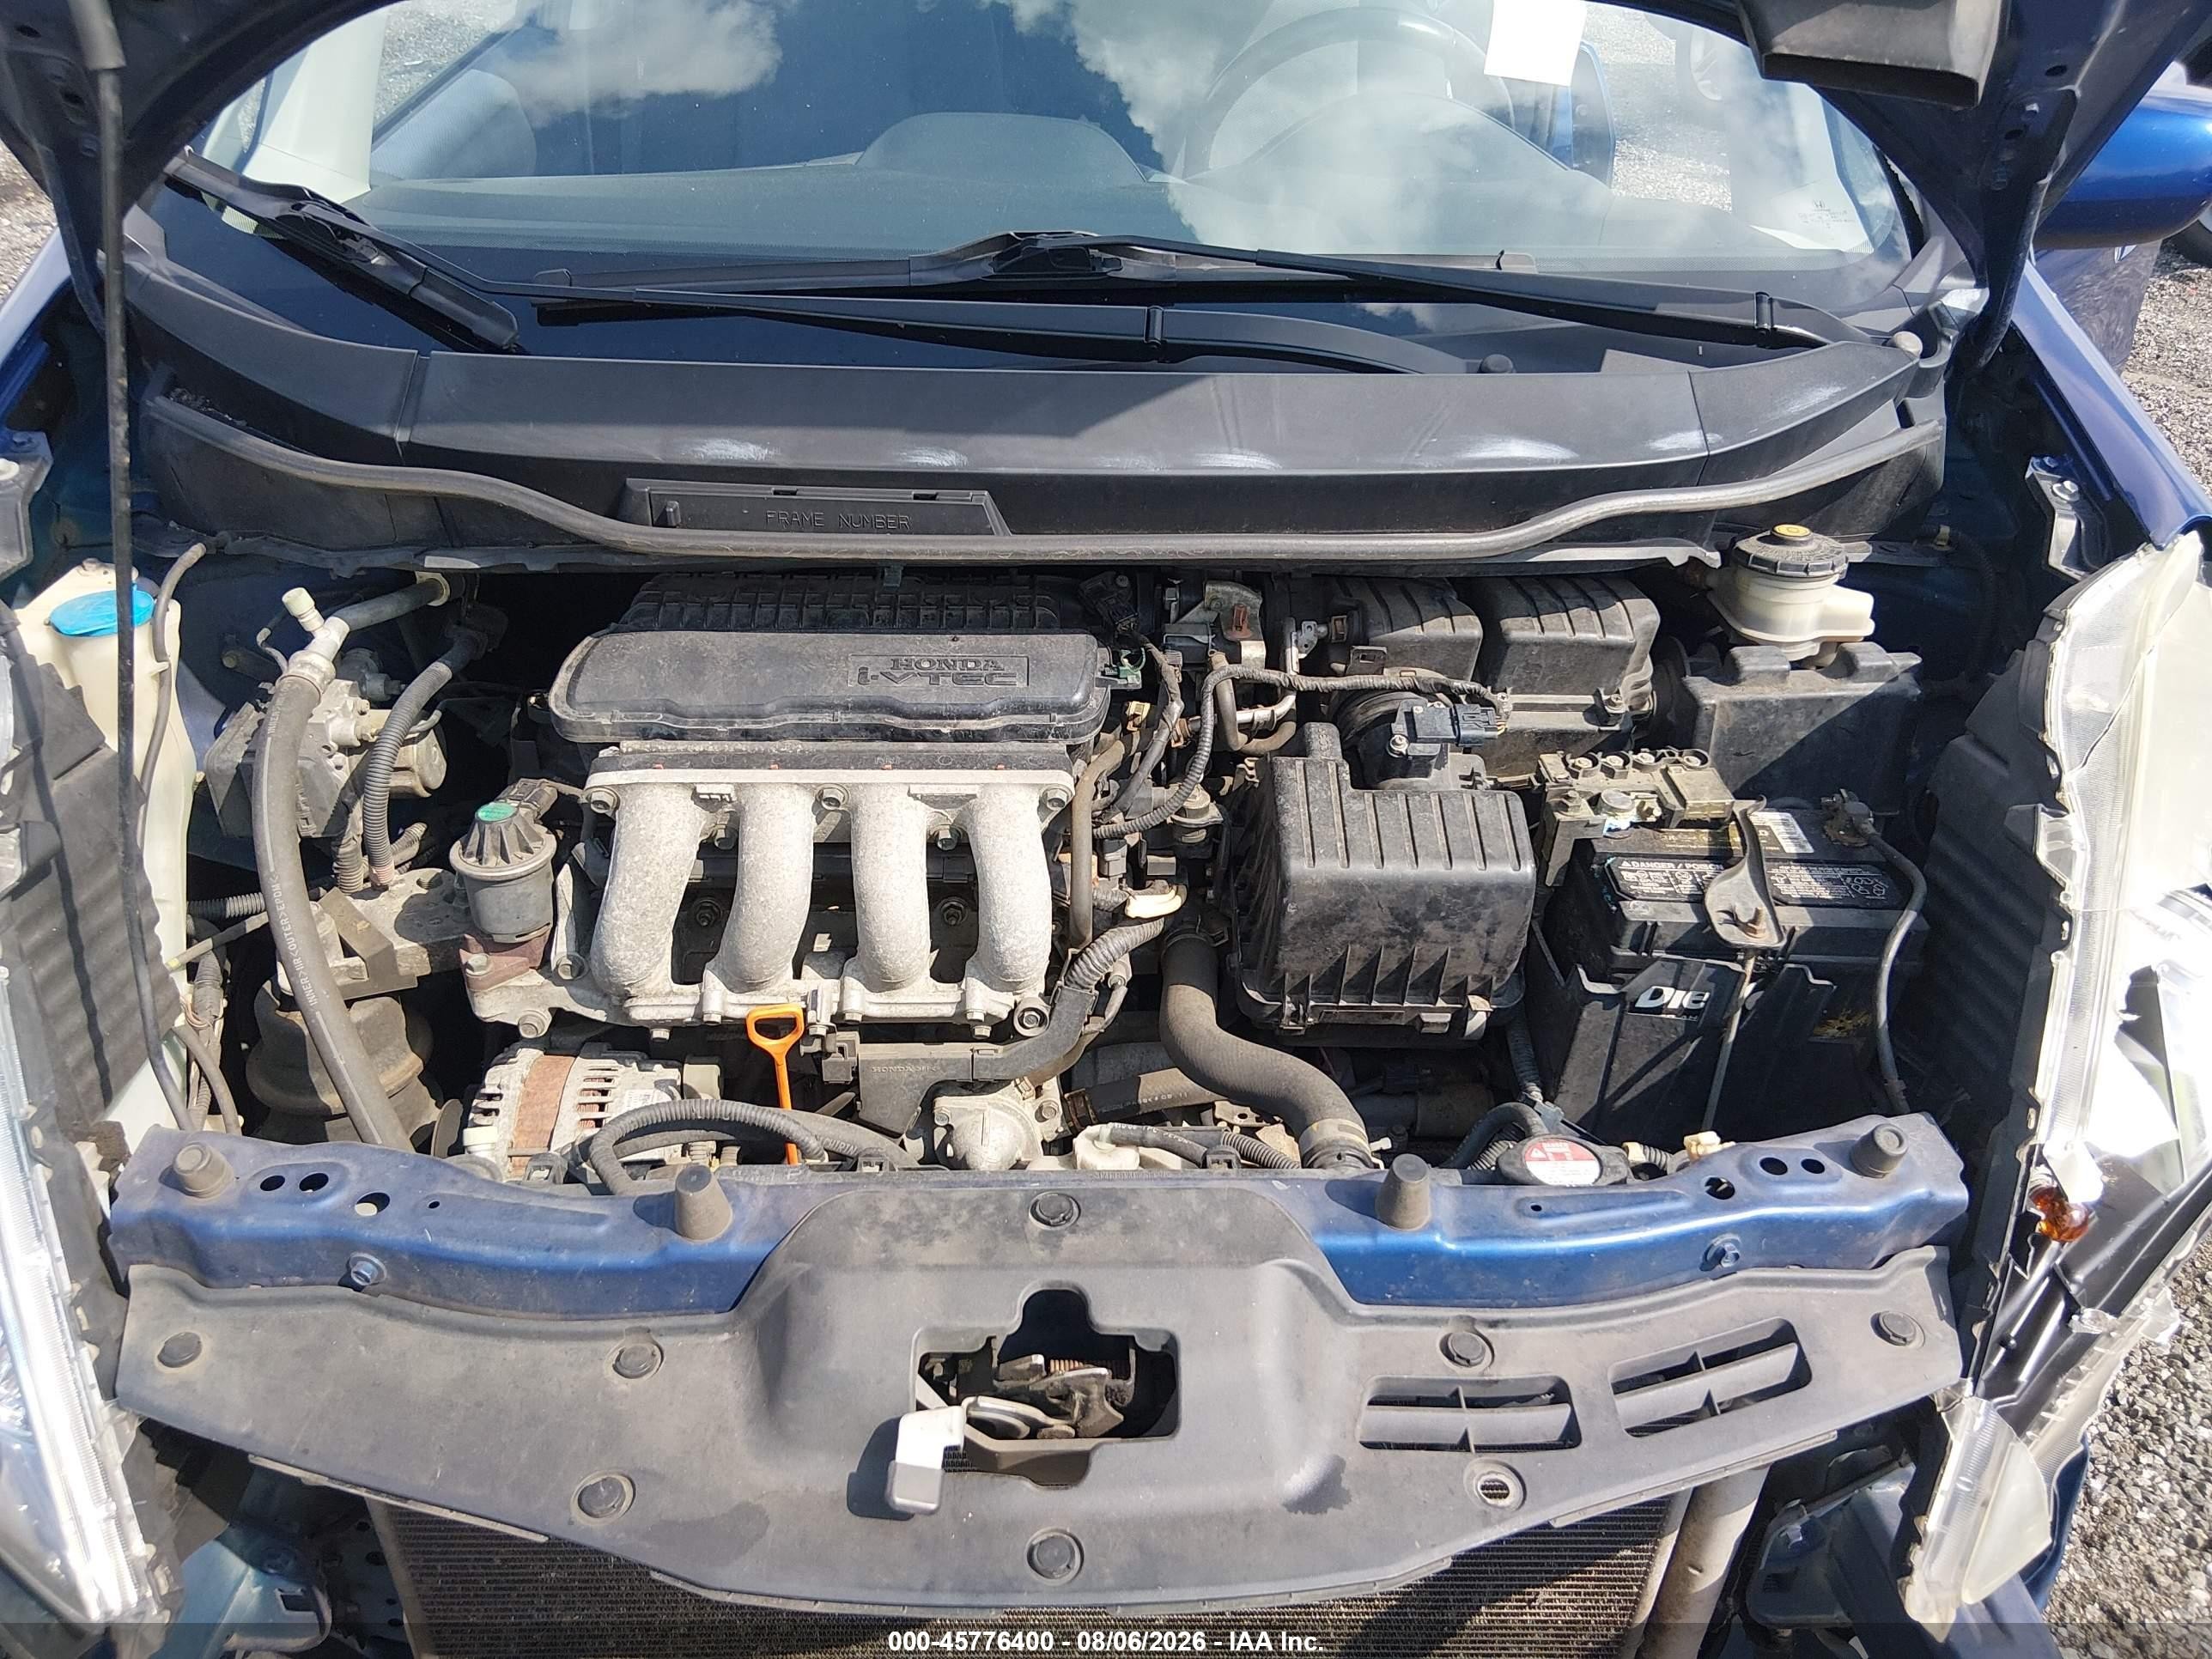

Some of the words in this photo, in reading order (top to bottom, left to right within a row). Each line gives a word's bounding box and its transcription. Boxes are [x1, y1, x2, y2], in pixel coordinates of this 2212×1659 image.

[765, 510, 825, 527] FRAME
[838, 513, 912, 530] NUMBER
[890, 658, 1006, 672] HONDA
[858, 666, 1018, 686] i-VTEC
